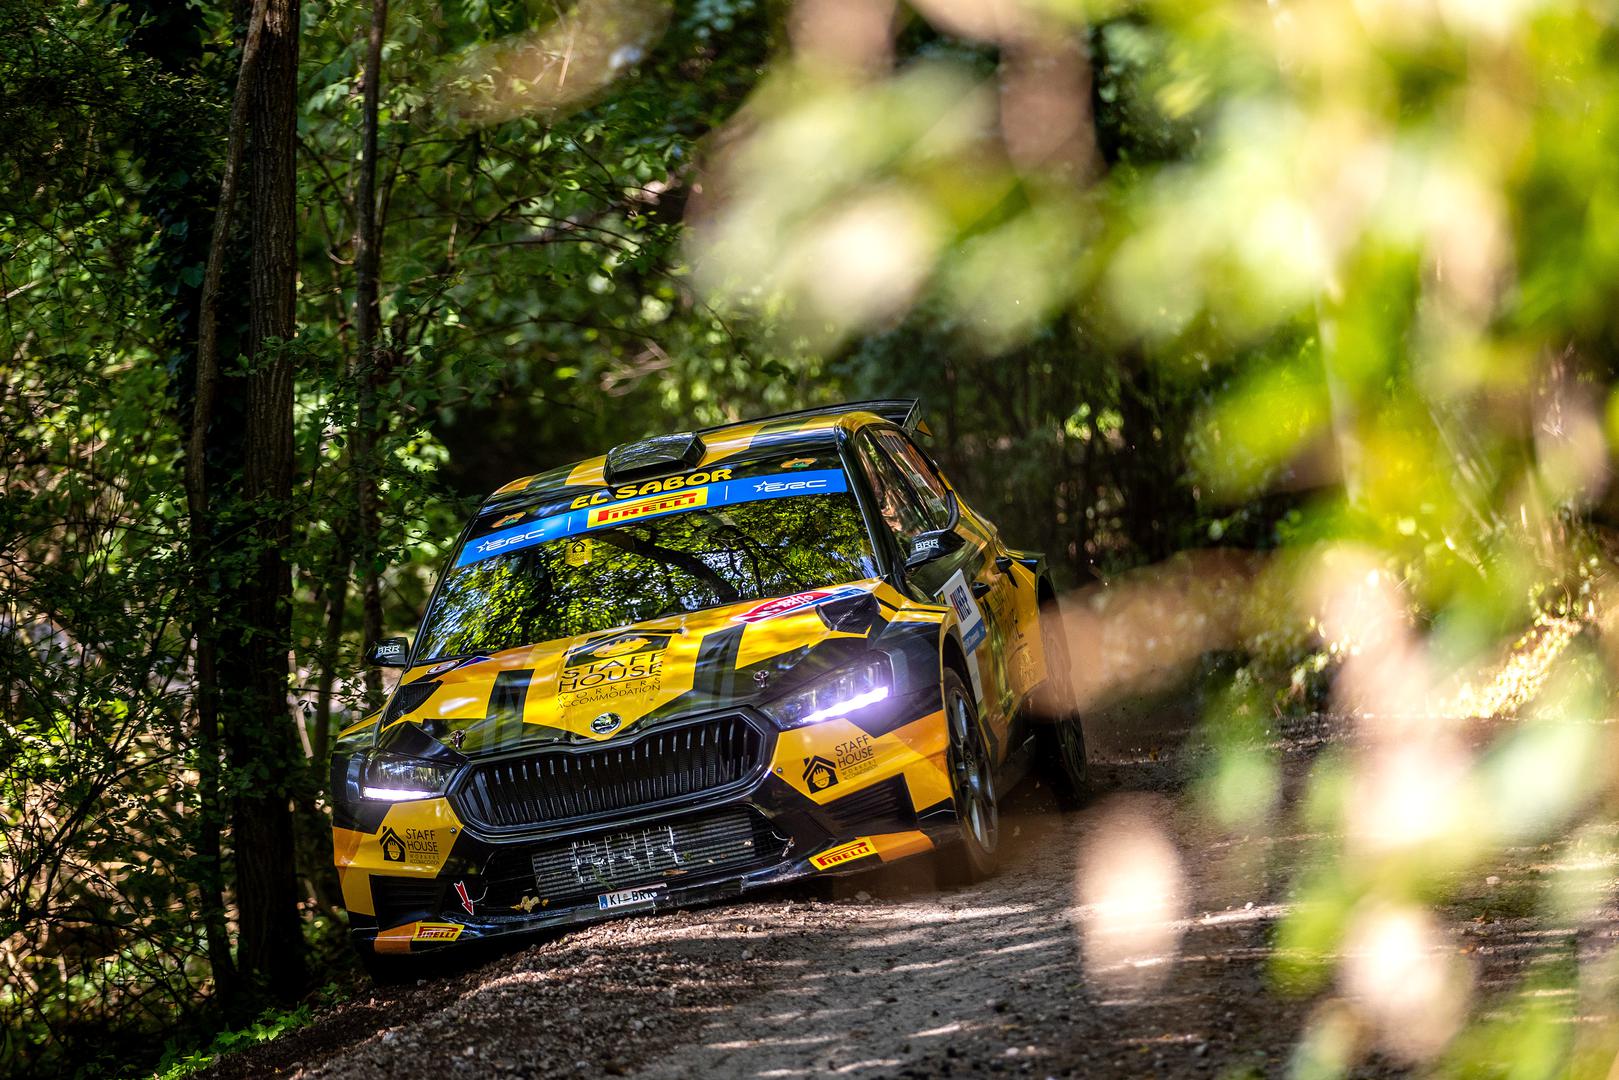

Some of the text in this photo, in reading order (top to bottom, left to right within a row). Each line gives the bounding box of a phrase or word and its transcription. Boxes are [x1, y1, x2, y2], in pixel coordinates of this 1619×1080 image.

[570, 468, 733, 510] EL SABOR
[597, 492, 698, 522] PIRELLI
[915, 538, 940, 551] BRR
[558, 661, 664, 693] HOUSE
[561, 653, 665, 679] STAFF
[834, 734, 869, 757] STAFF
[837, 745, 874, 768] HOUSE
[405, 828, 436, 841] STAFF
[406, 840, 439, 852] HOUSE
[816, 841, 870, 867] PIRELLI
[417, 926, 459, 938] PIRELLI
